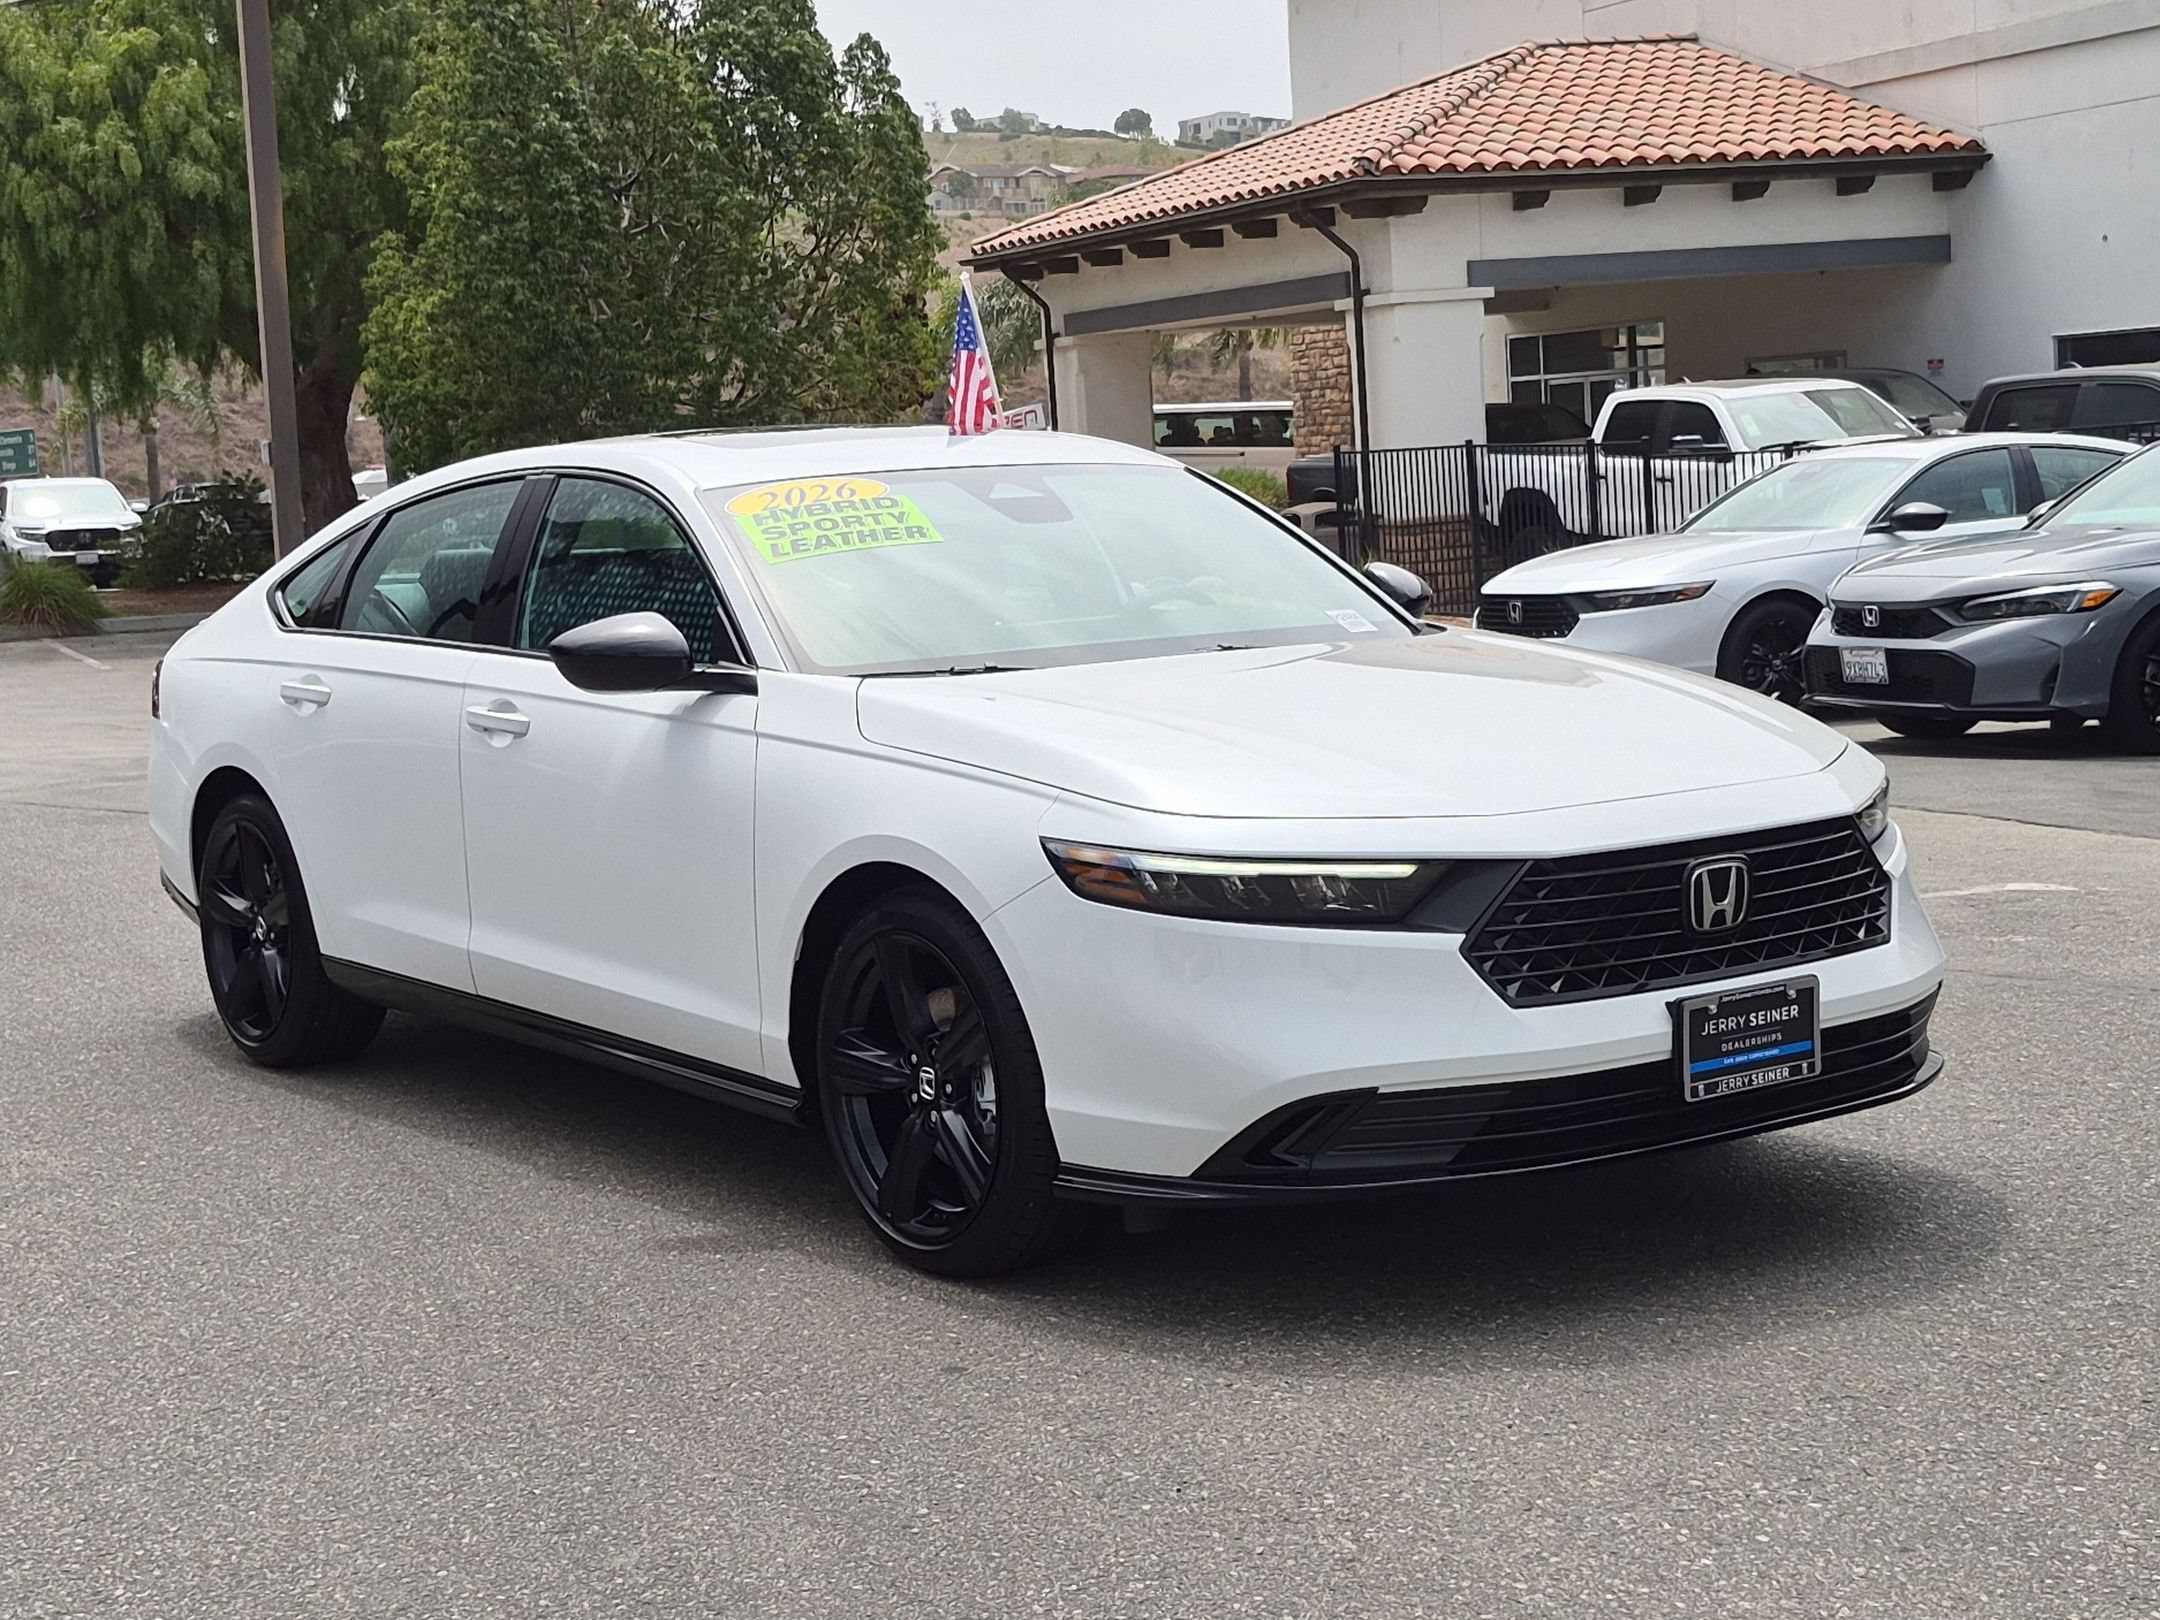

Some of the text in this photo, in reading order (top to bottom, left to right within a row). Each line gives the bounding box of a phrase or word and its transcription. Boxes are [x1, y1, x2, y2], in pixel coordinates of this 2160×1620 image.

[752, 497, 902, 526] HYBRID
[759, 483, 857, 511] 2026
[761, 511, 909, 541] SPORTY
[770, 525, 929, 558] LEATHER
[1701, 1005, 1799, 1036] JERRY SEINER
[1721, 1032, 1782, 1052] DEALERSHIPS
[1716, 1067, 1790, 1093] JERRY SEINER
